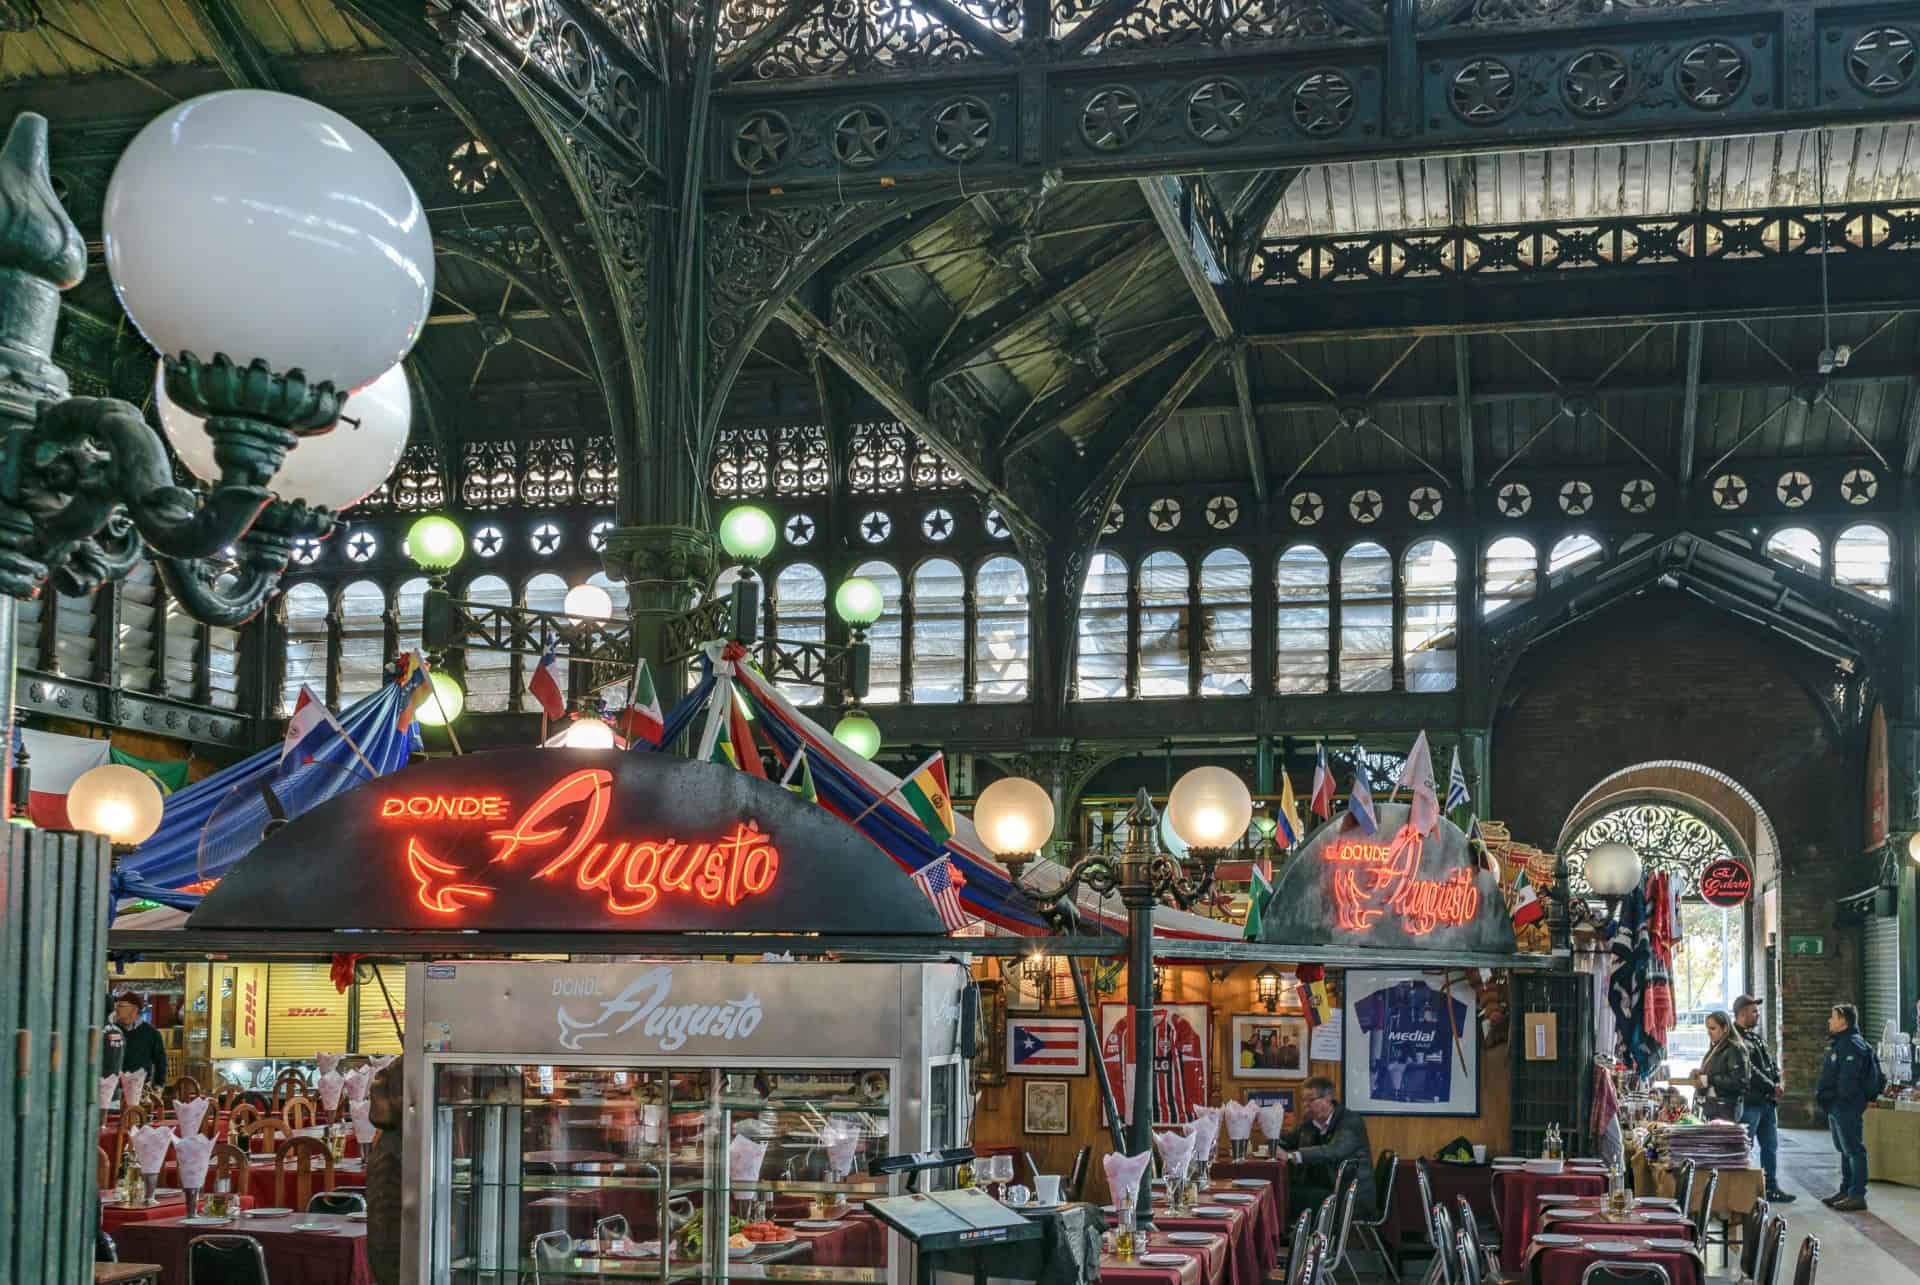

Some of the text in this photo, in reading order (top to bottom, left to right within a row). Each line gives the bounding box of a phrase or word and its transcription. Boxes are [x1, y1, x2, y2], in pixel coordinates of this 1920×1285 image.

[381, 796, 507, 820] DONDE
[487, 768, 779, 915] Augusto
[1367, 829, 1478, 935] Augusto
[244, 980, 257, 1037] DHL
[287, 1007, 329, 1017] DHL
[600, 966, 763, 1050] Augusto
[1388, 1030, 1437, 1042] Medial
[1154, 1061, 1169, 1070] LG
